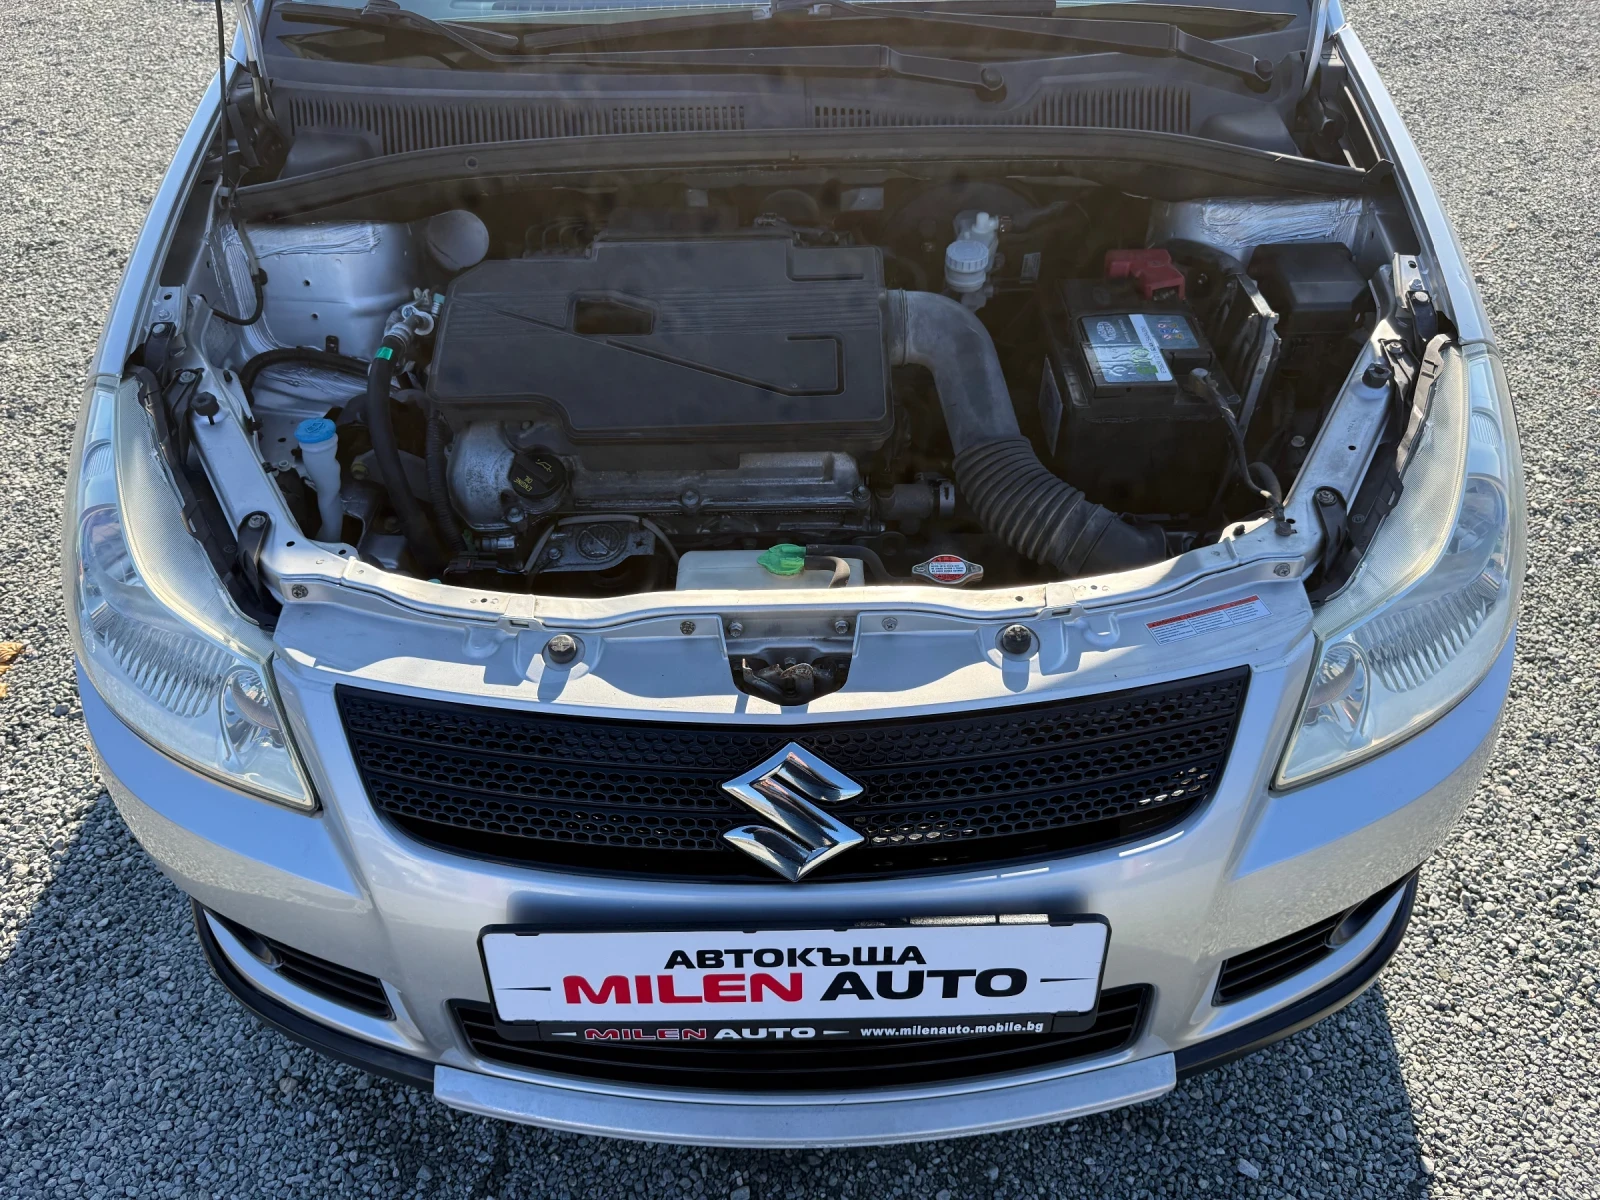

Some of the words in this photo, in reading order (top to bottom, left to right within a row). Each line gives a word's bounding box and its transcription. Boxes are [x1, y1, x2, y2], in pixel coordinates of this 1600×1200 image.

[513, 476, 533, 492] ENGINE
[562, 972, 803, 1004] MILEN
[819, 967, 1028, 1001] AUTO
[584, 1028, 707, 1040] MILEN
[713, 1027, 816, 1040] AUTO
[860, 1021, 1044, 1037] www.milenauto.mobile.bg
